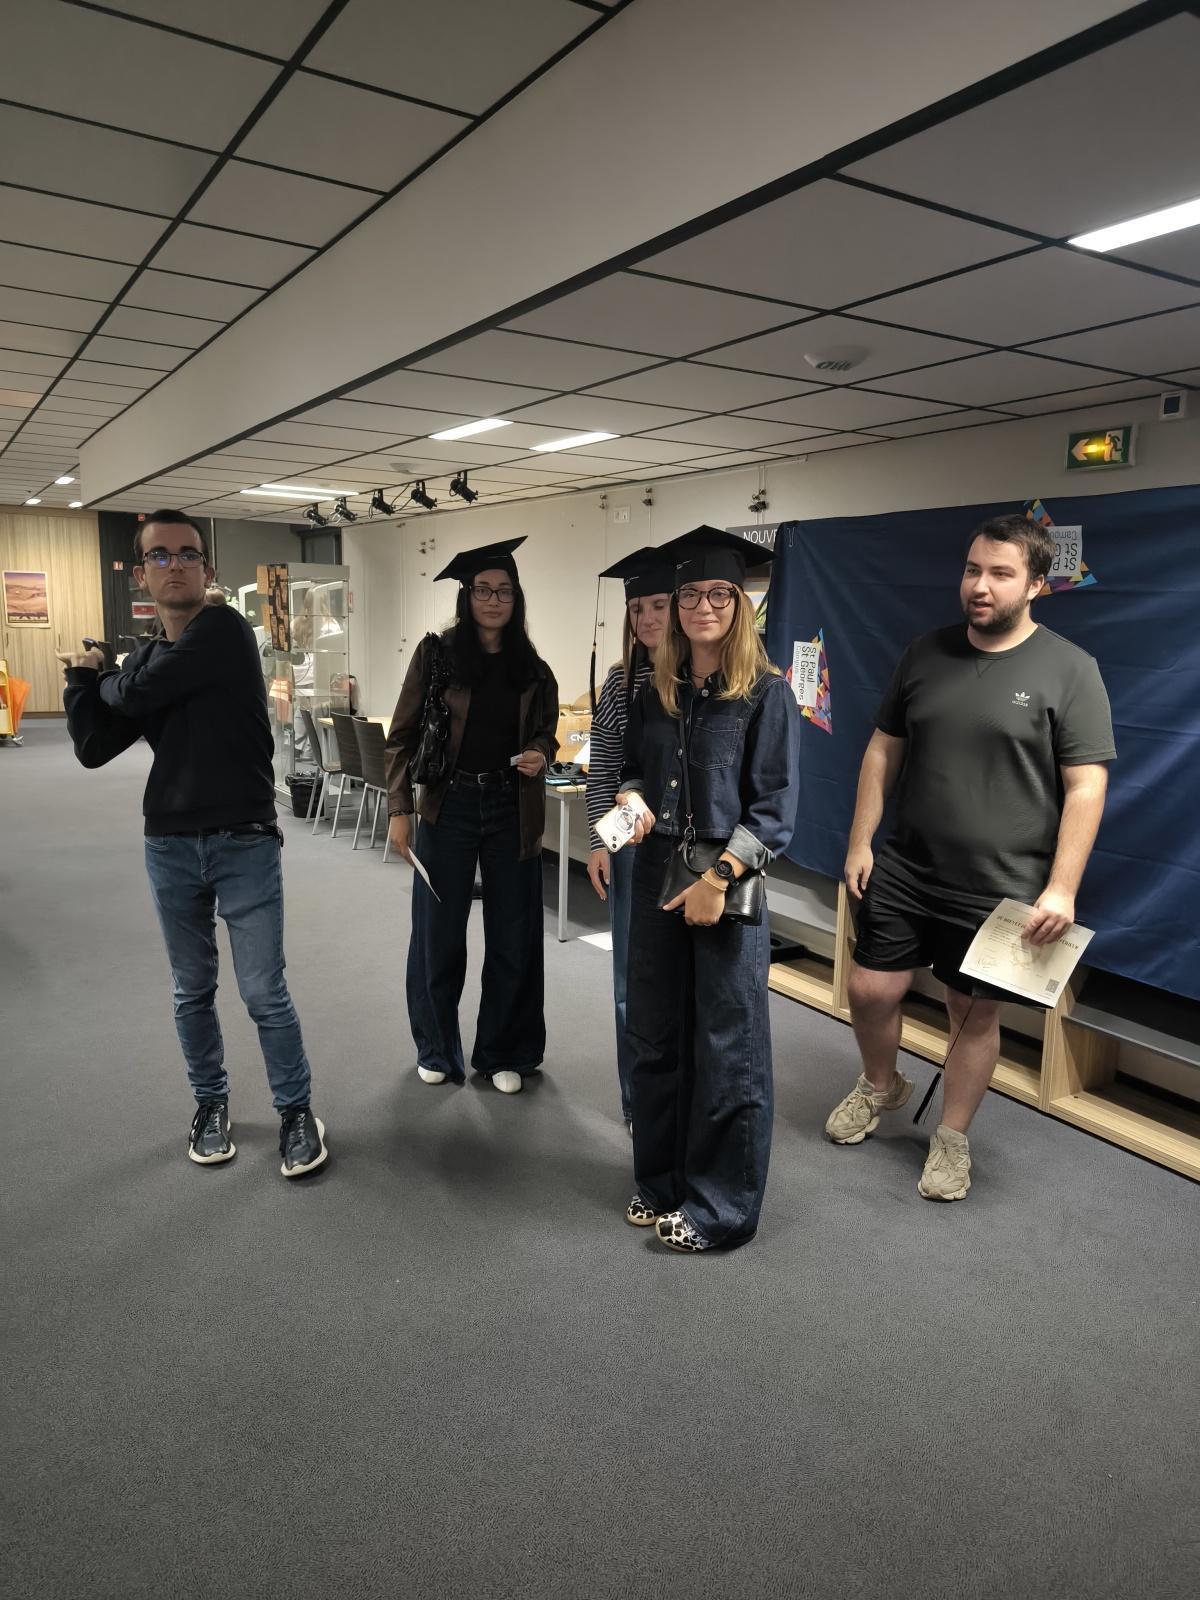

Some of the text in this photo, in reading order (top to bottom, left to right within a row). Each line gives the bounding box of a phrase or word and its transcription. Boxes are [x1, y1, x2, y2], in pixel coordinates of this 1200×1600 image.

[1065, 543, 1077, 556] St
[1064, 557, 1076, 570] St
[798, 646, 810, 700] St Georges
[807, 647, 817, 683] St Paul
